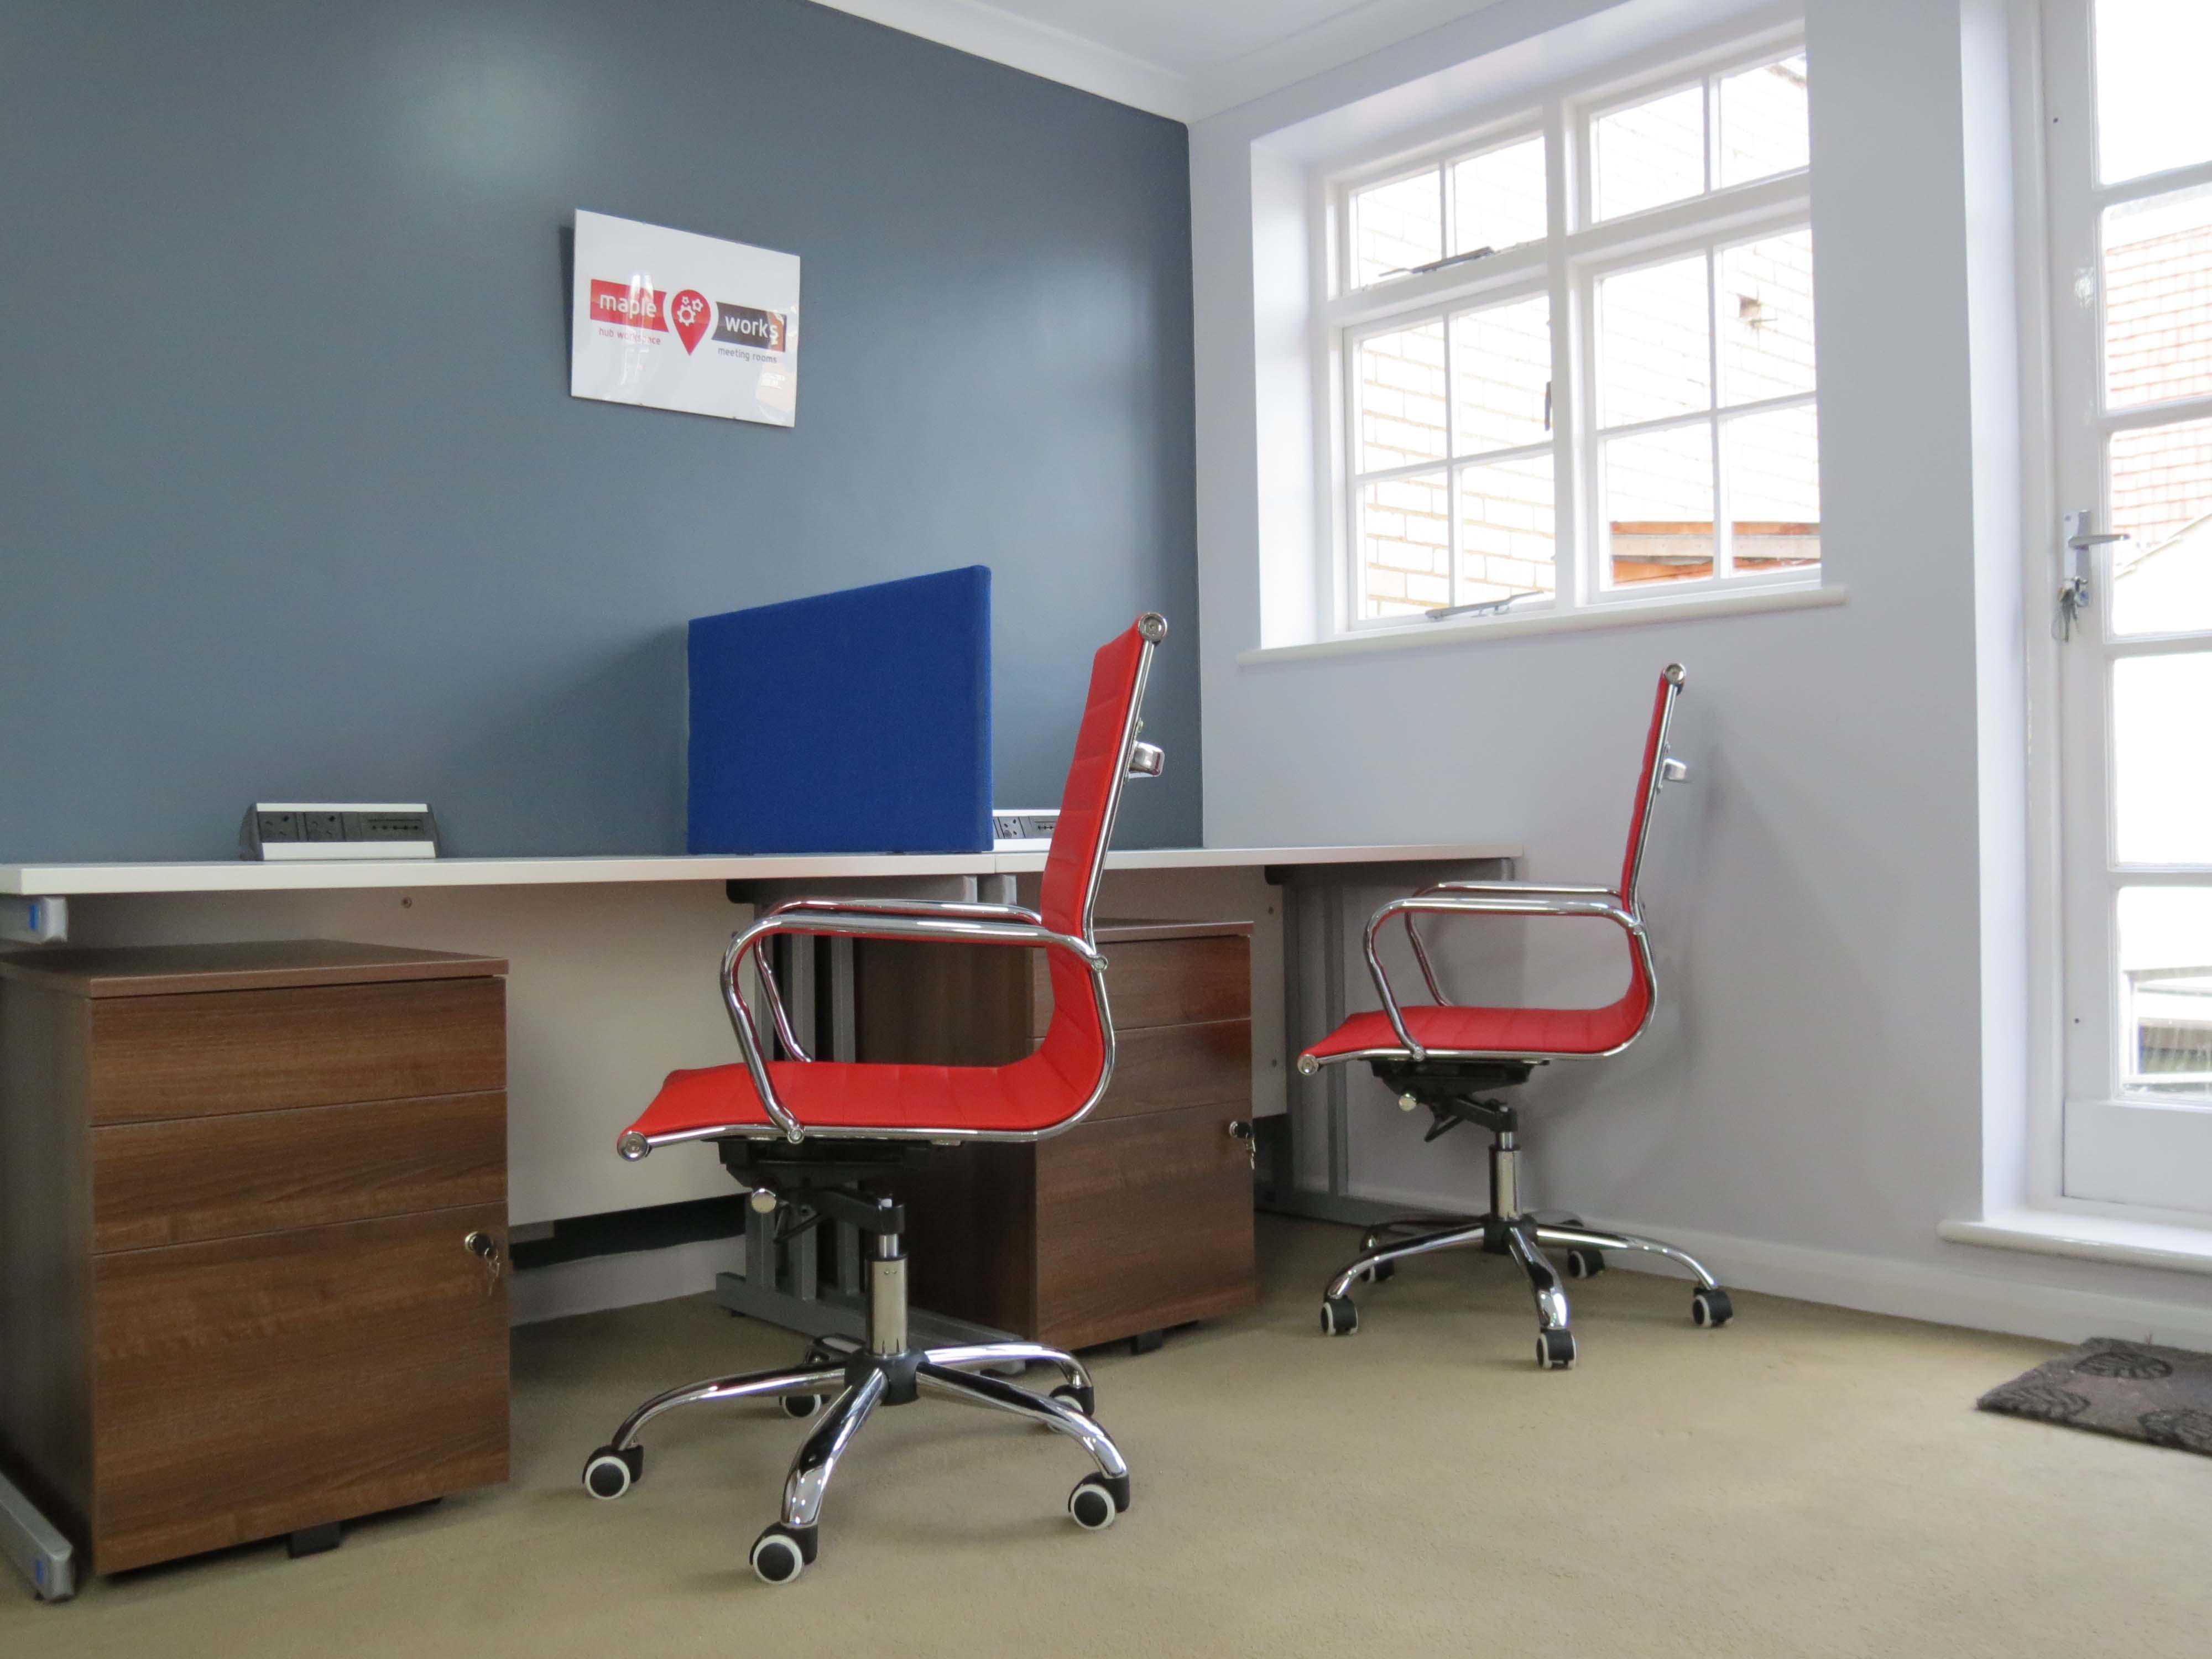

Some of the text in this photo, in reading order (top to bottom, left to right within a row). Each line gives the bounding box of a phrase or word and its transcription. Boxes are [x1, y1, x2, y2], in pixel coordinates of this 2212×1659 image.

[599, 294, 779, 339] maple works
[599, 327, 614, 338] hub
[718, 347, 778, 363] meeting rooms
